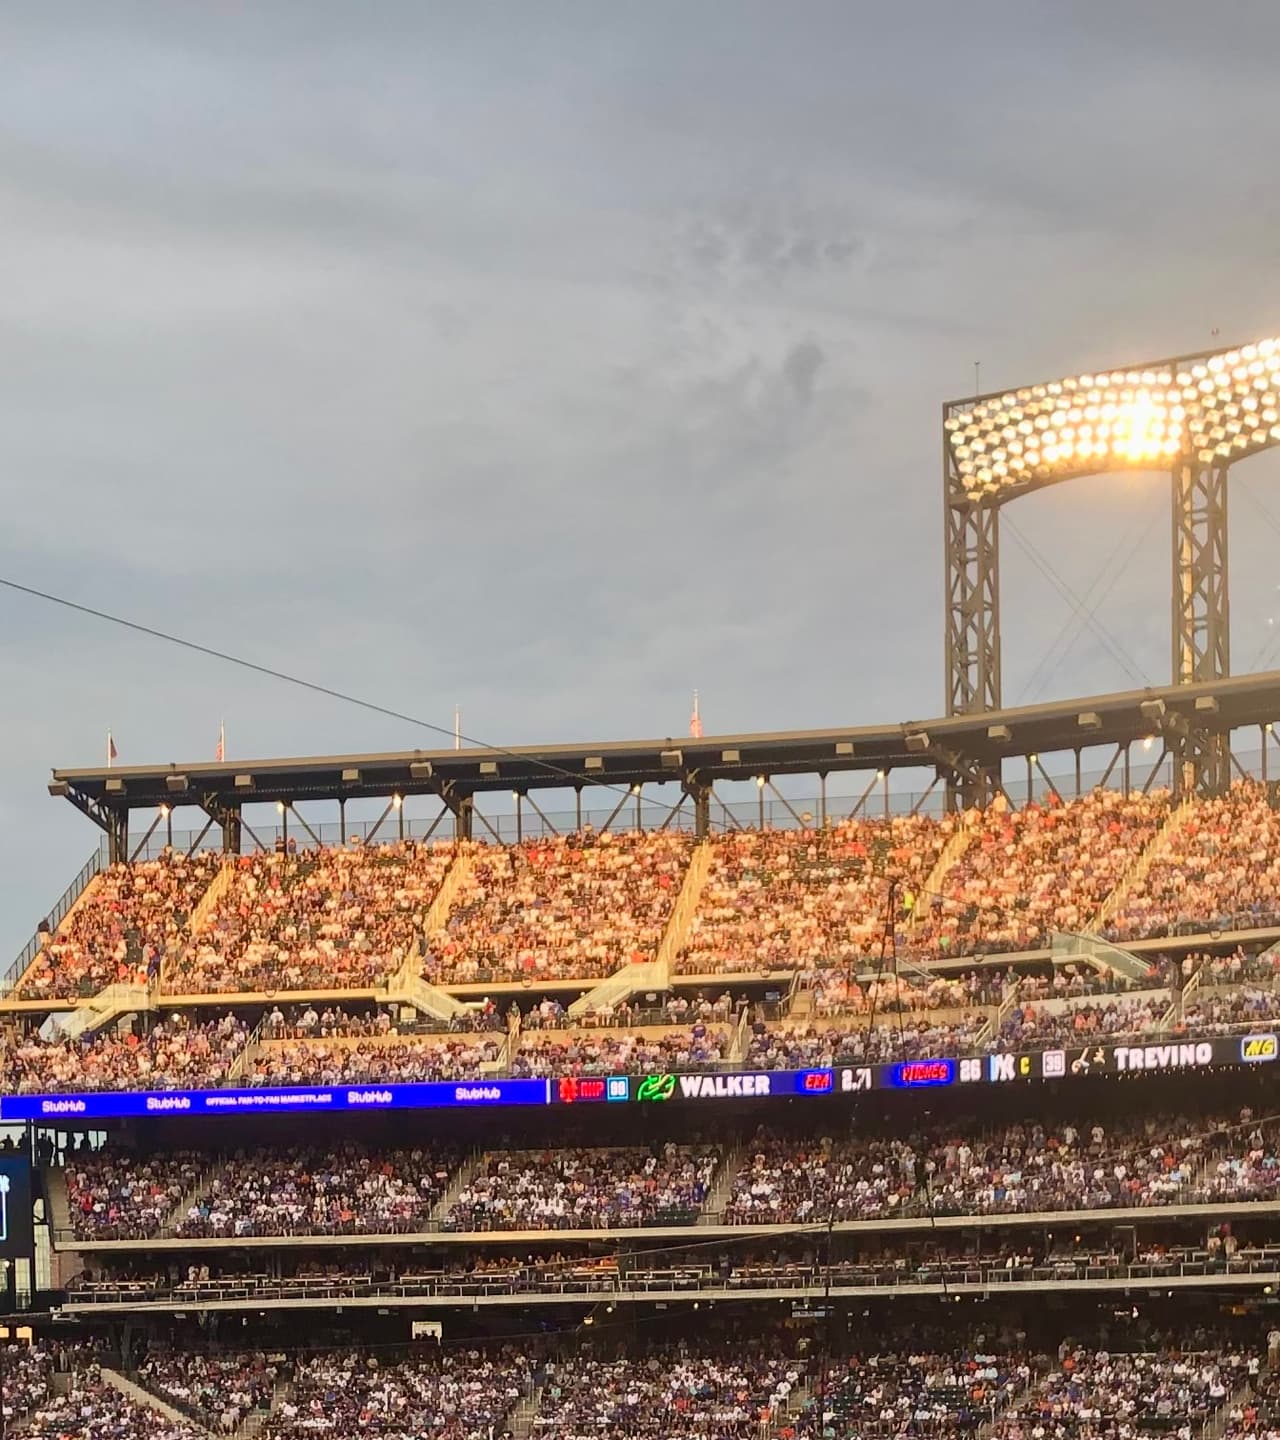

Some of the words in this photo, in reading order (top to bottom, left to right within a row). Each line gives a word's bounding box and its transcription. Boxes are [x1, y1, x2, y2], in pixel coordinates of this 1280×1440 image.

[1114, 1043, 1212, 1070] TREVINO
[679, 1075, 770, 1098] WALKER
[804, 1072, 831, 1089] ERA
[348, 1090, 392, 1103] StubHub
[456, 1087, 500, 1100] StubHub
[42, 1101, 86, 1113] StubHub
[146, 1097, 190, 1110] StubHub
